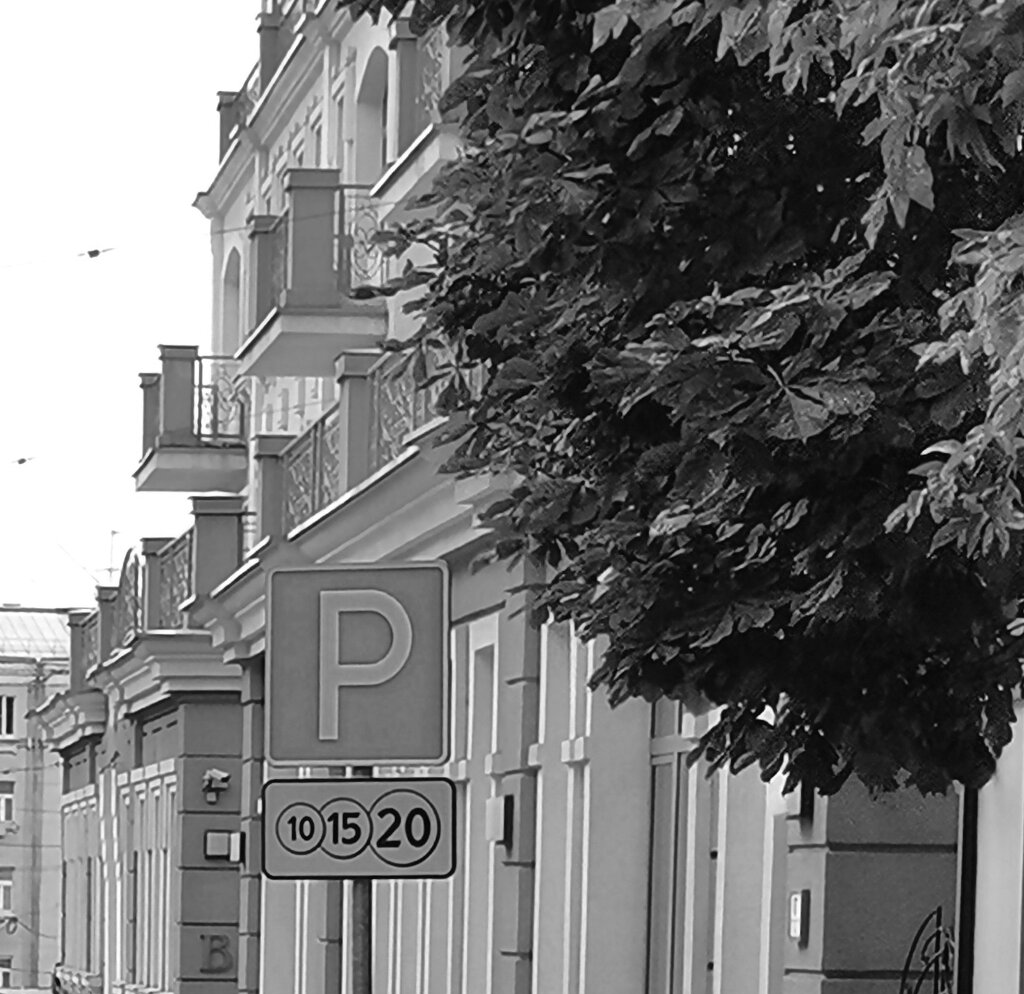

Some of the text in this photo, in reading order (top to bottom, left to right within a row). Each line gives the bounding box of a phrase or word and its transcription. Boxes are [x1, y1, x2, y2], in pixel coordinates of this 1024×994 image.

[318, 588, 413, 741] P
[286, 806, 432, 849] 10 15 20
